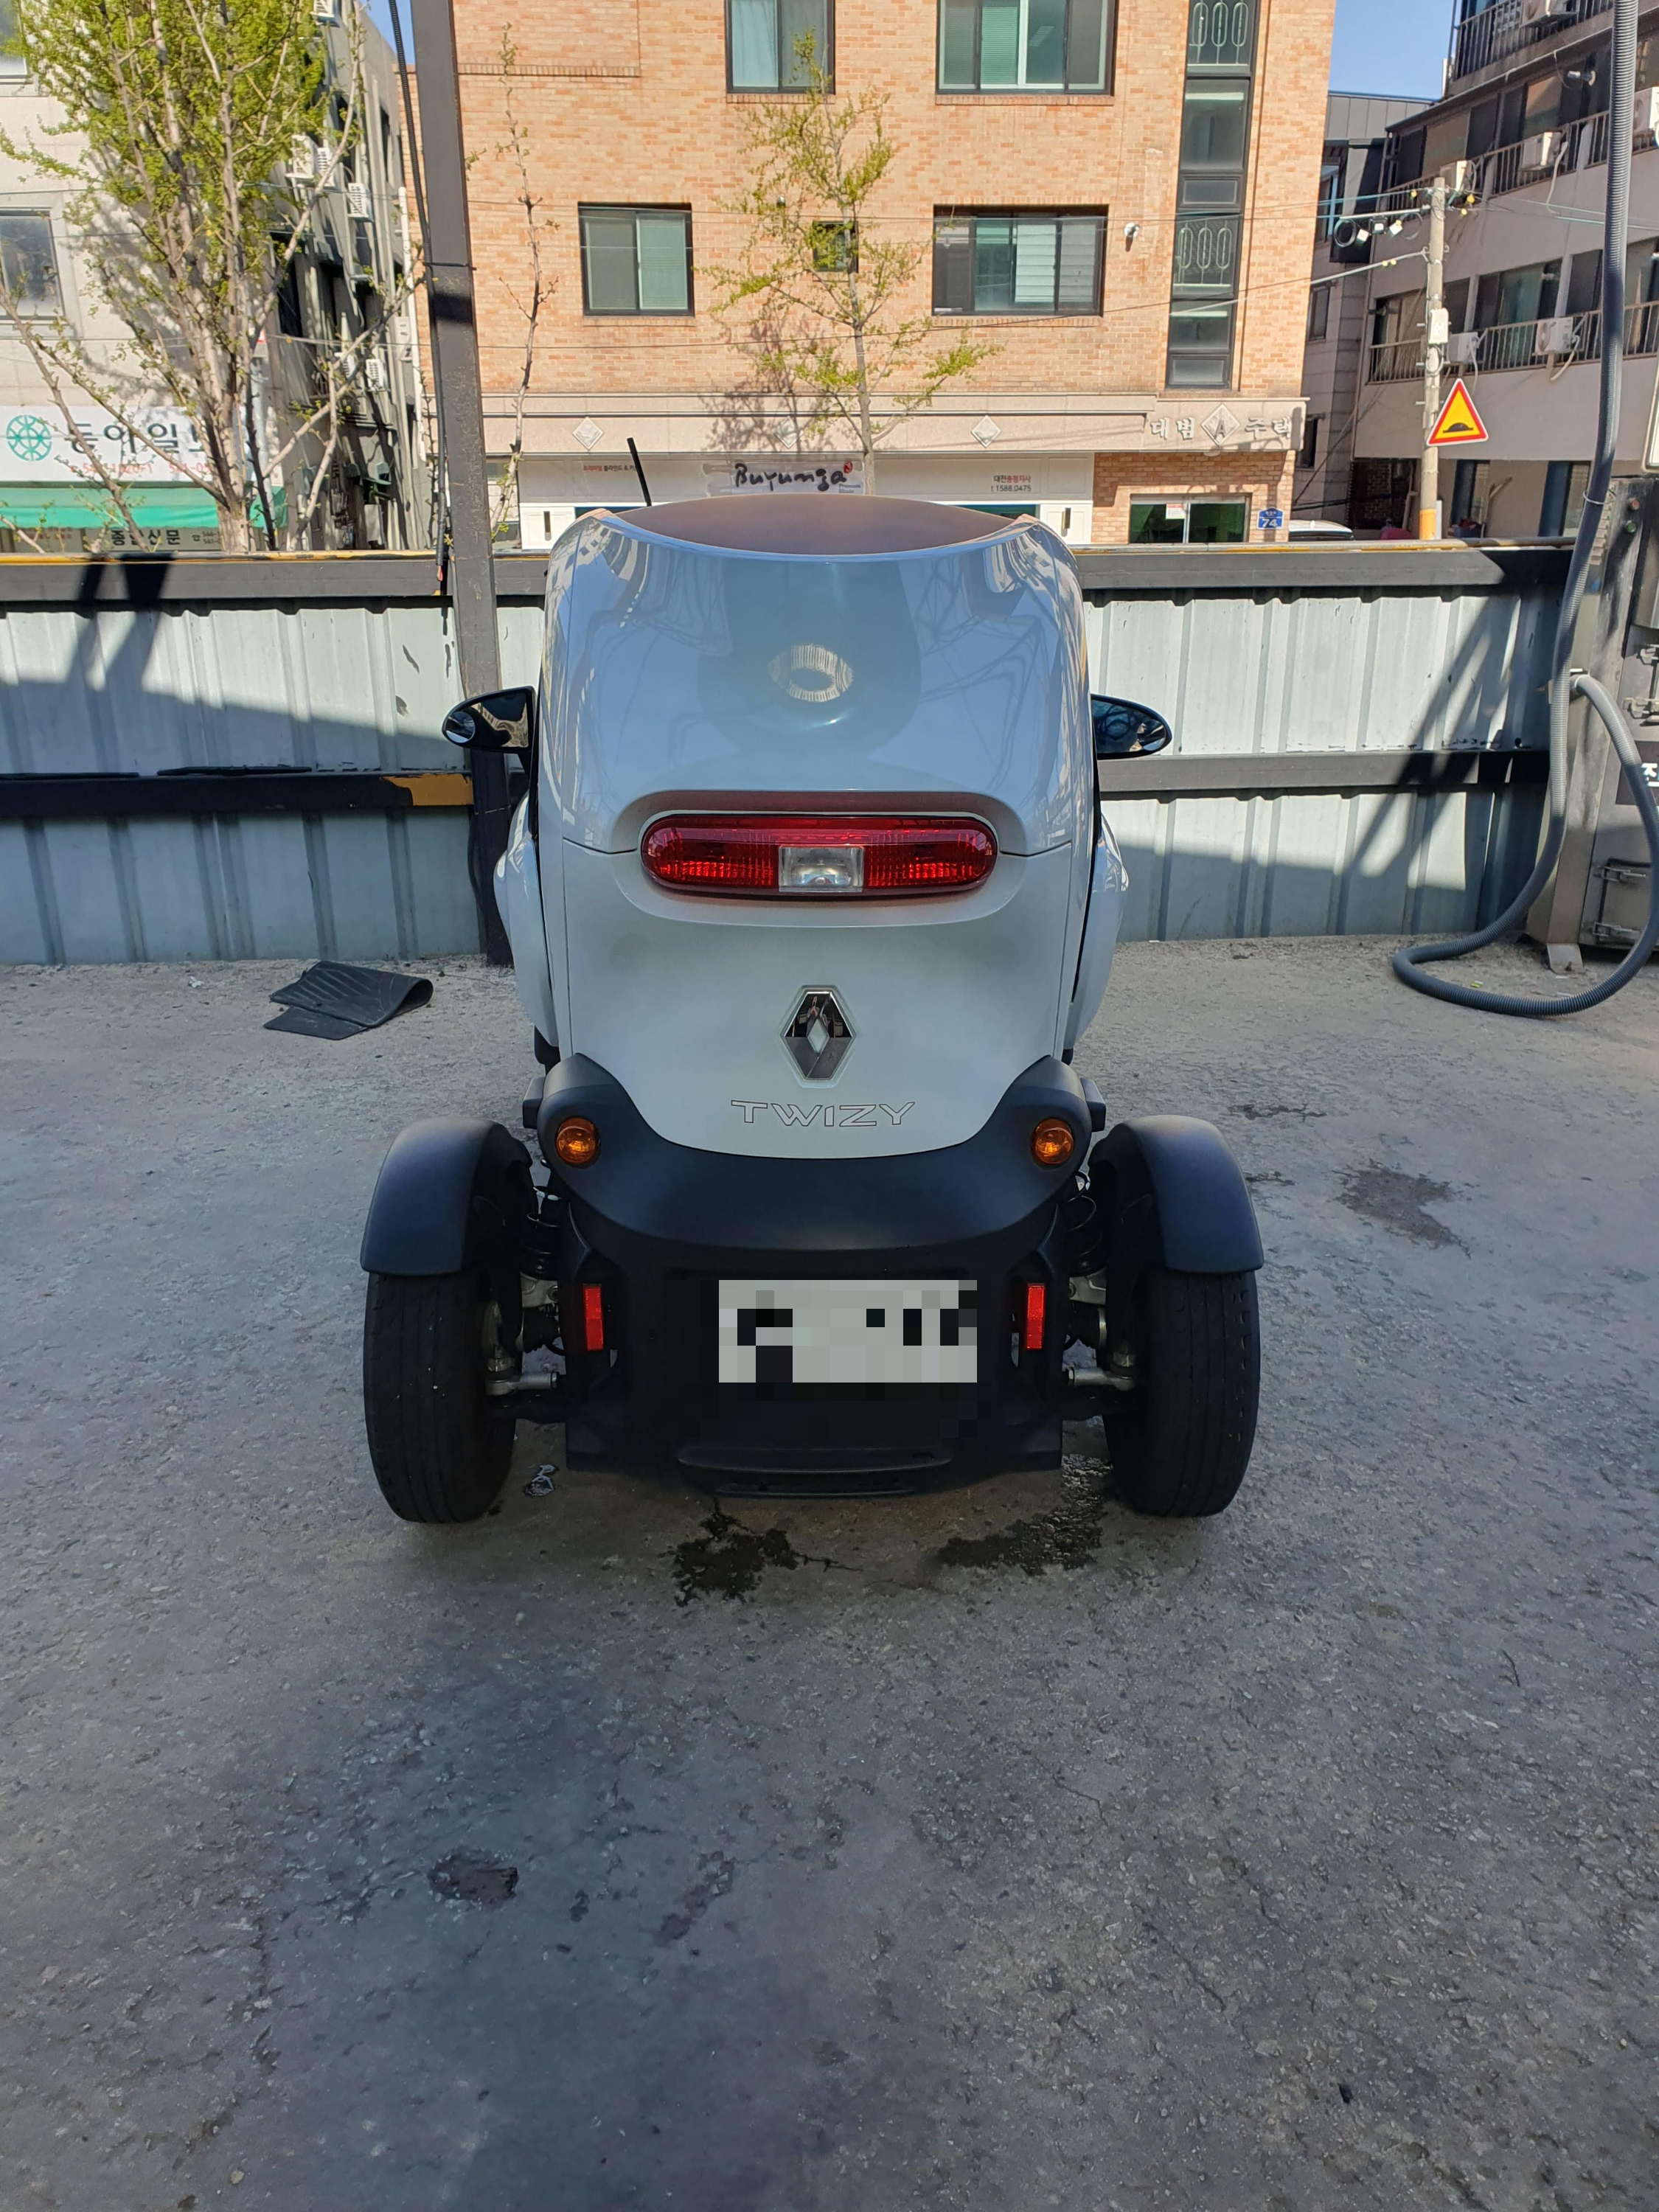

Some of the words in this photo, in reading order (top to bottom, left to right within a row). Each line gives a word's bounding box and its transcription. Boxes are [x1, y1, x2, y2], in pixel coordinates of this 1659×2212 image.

[1245, 416, 1293, 439] 주택
[735, 463, 847, 491] Buyunga
[1262, 518, 1279, 527] 74
[731, 1099, 915, 1127] TWIZY
